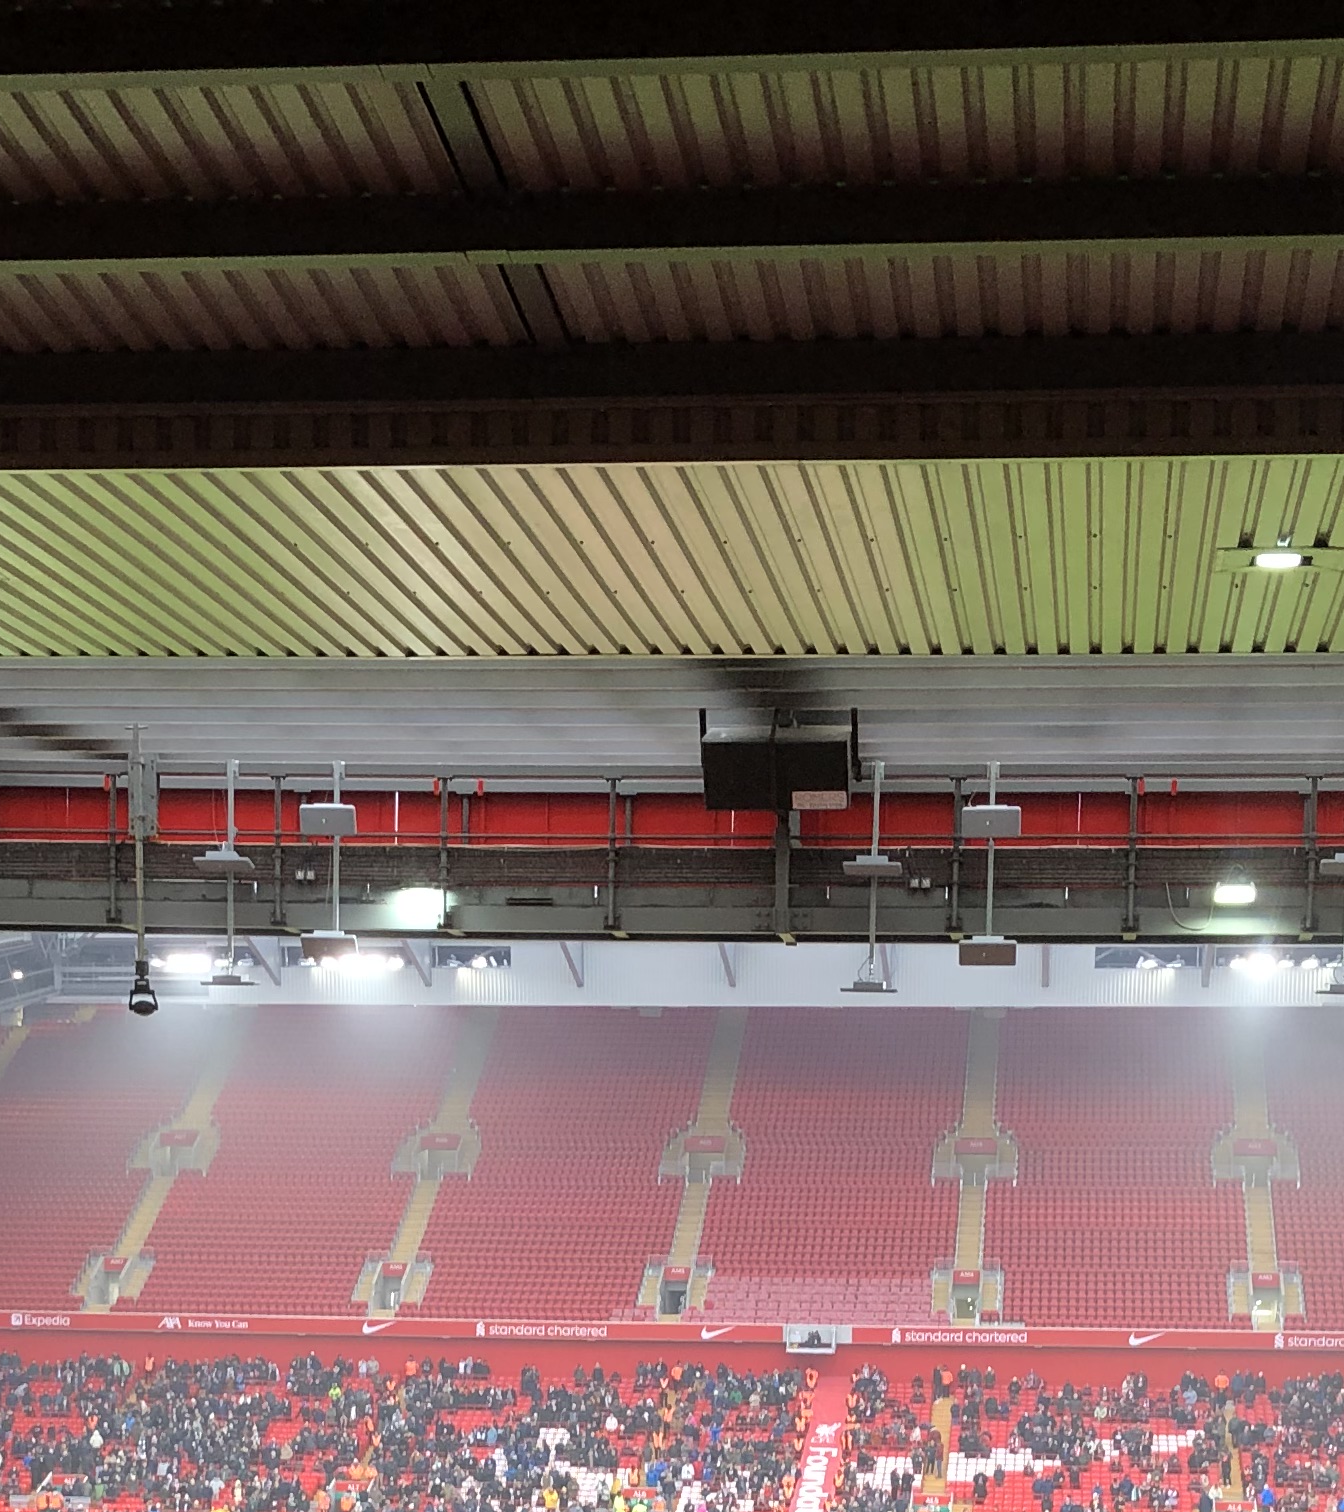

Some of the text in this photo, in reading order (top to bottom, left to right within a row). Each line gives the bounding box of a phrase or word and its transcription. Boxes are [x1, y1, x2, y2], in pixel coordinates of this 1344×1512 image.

[24, 1313, 71, 1327] Expedia
[188, 1319, 248, 1331] Know You Can
[489, 1323, 608, 1338] standard chartered
[904, 1330, 1028, 1344] standard chartered
